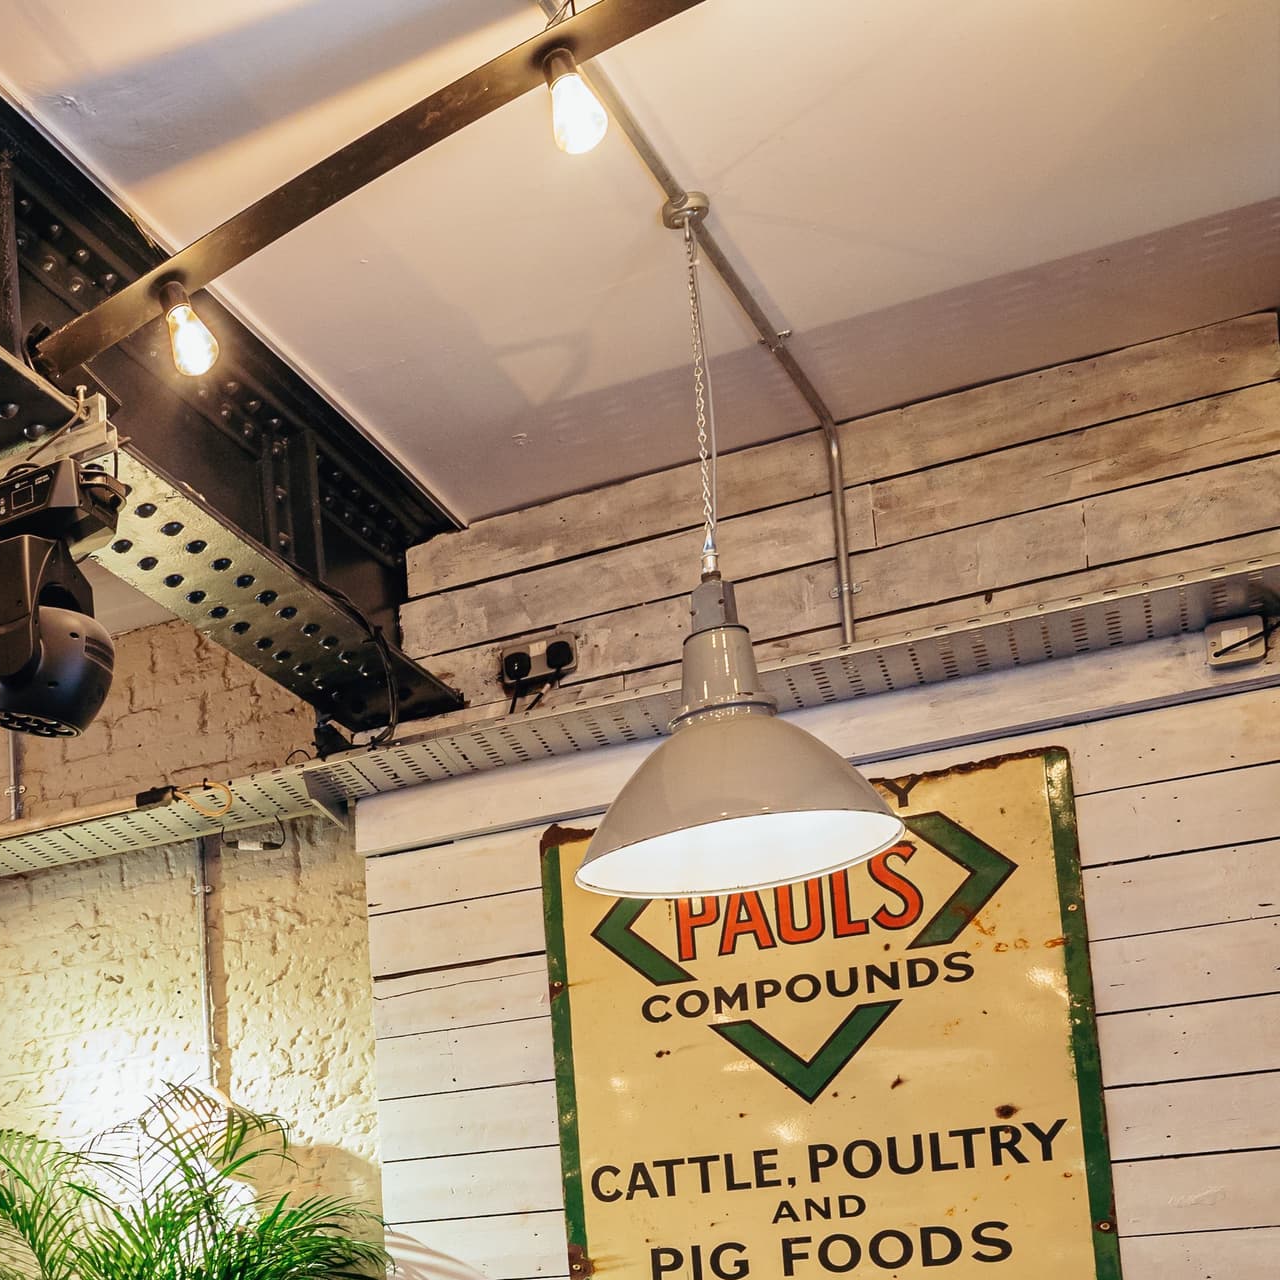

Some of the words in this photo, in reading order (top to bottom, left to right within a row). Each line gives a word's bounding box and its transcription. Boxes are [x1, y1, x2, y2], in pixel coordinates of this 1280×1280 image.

[674, 840, 924, 962] PAULS
[641, 952, 975, 1024] COMPOUNDS
[591, 1149, 798, 1202] CATTLE,
[809, 1118, 1069, 1184] POULTRY
[772, 1193, 867, 1225] AND
[782, 1220, 1014, 1277] FOODS
